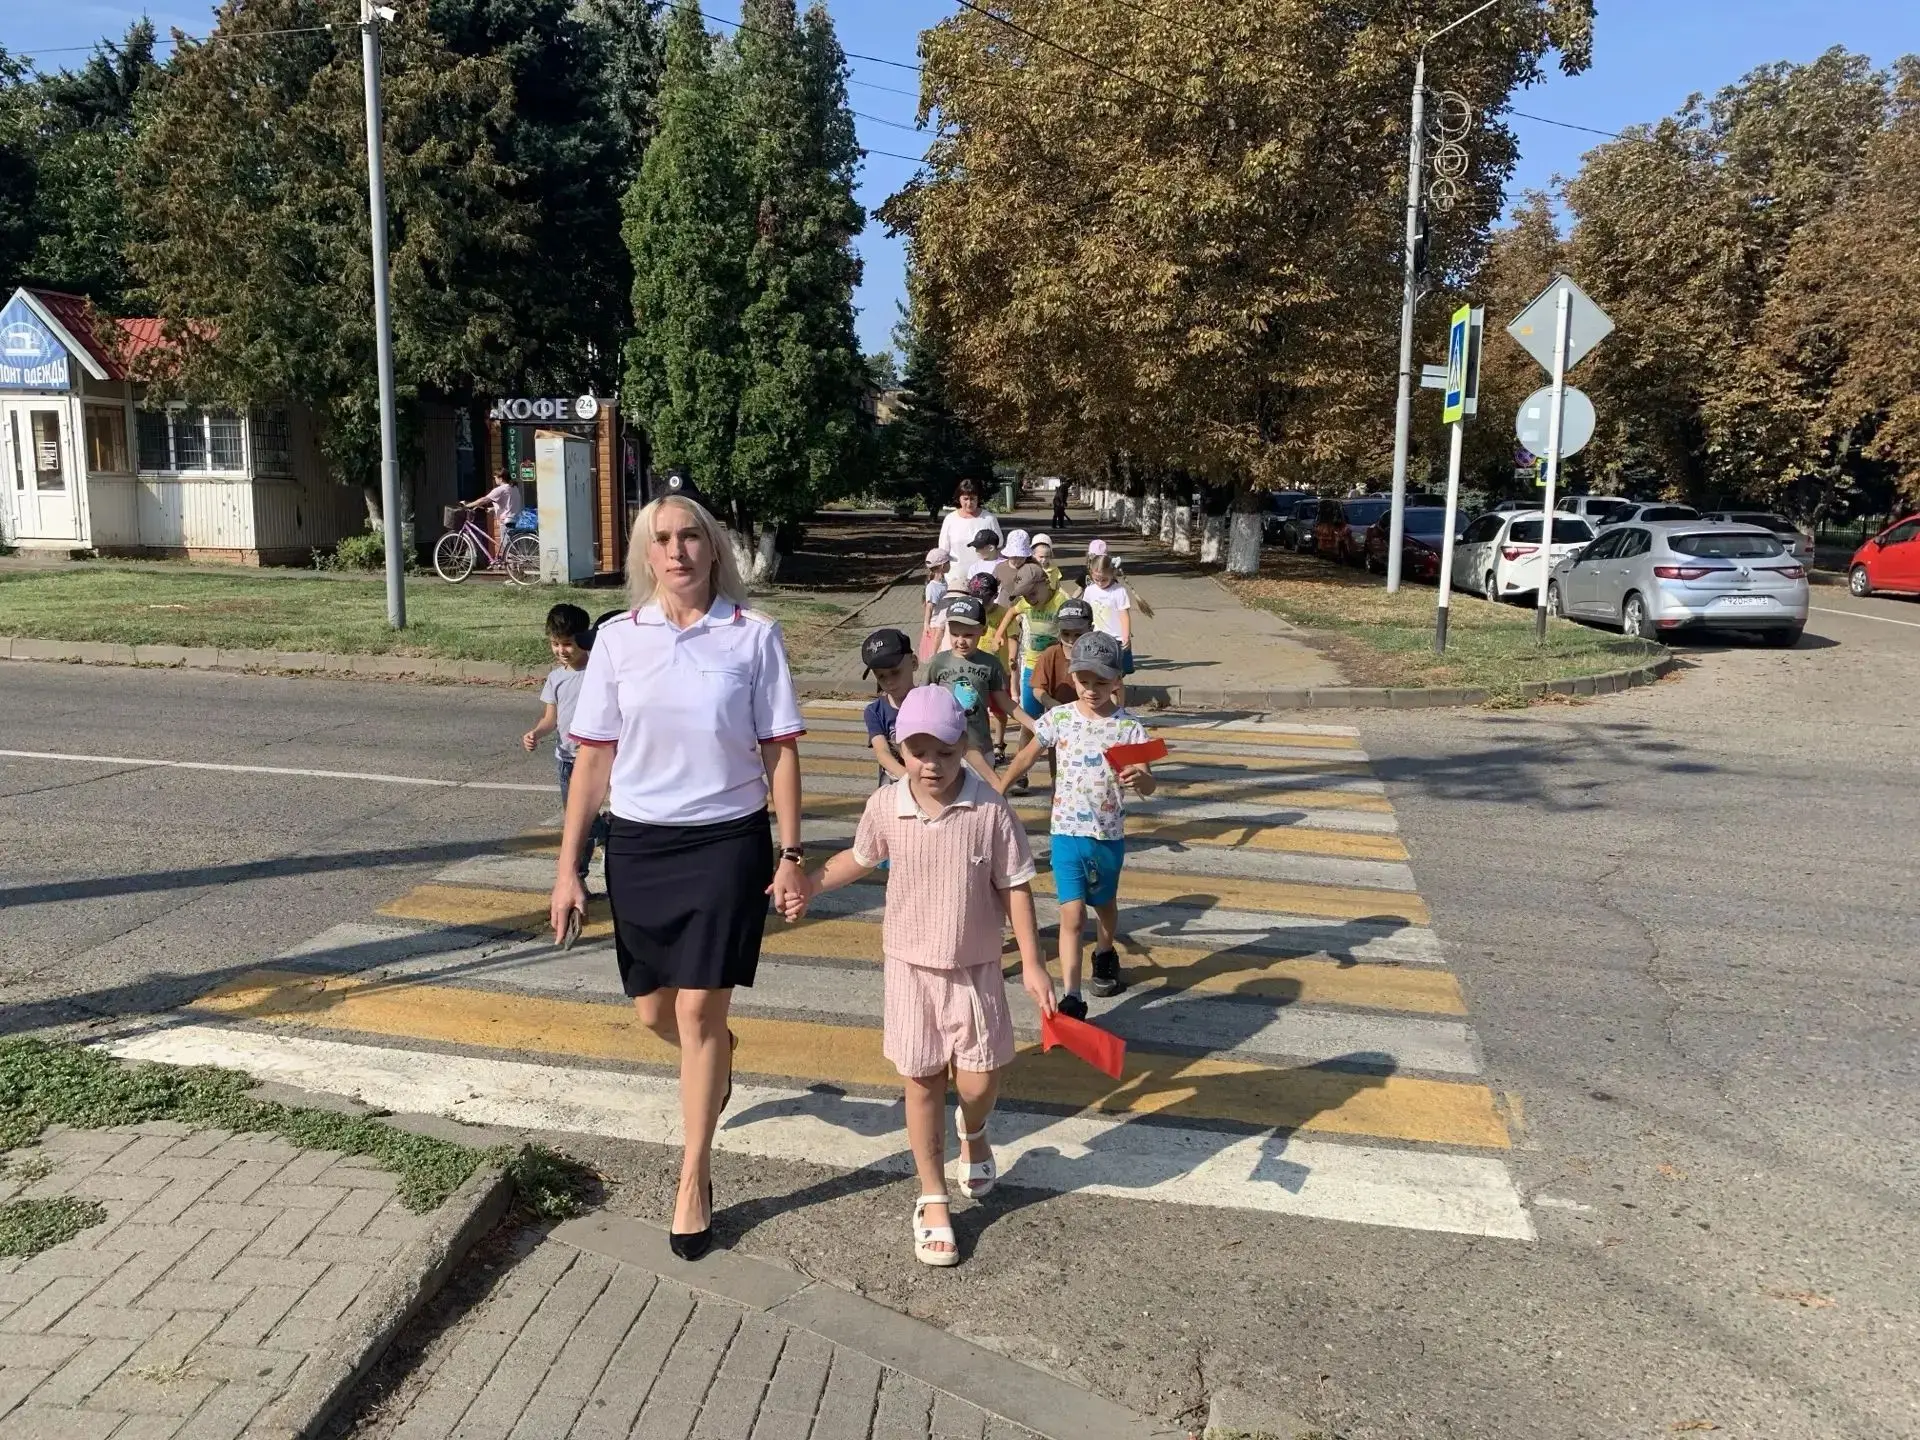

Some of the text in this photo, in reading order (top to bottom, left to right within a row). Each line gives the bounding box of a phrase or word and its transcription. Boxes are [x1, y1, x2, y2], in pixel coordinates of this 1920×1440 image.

[24, 357, 68, 387] ОДЕЖДЫ
[497, 398, 569, 420] КОФЕ
[579, 399, 593, 409] 24
[508, 428, 517, 479] ОТКРЫТО
